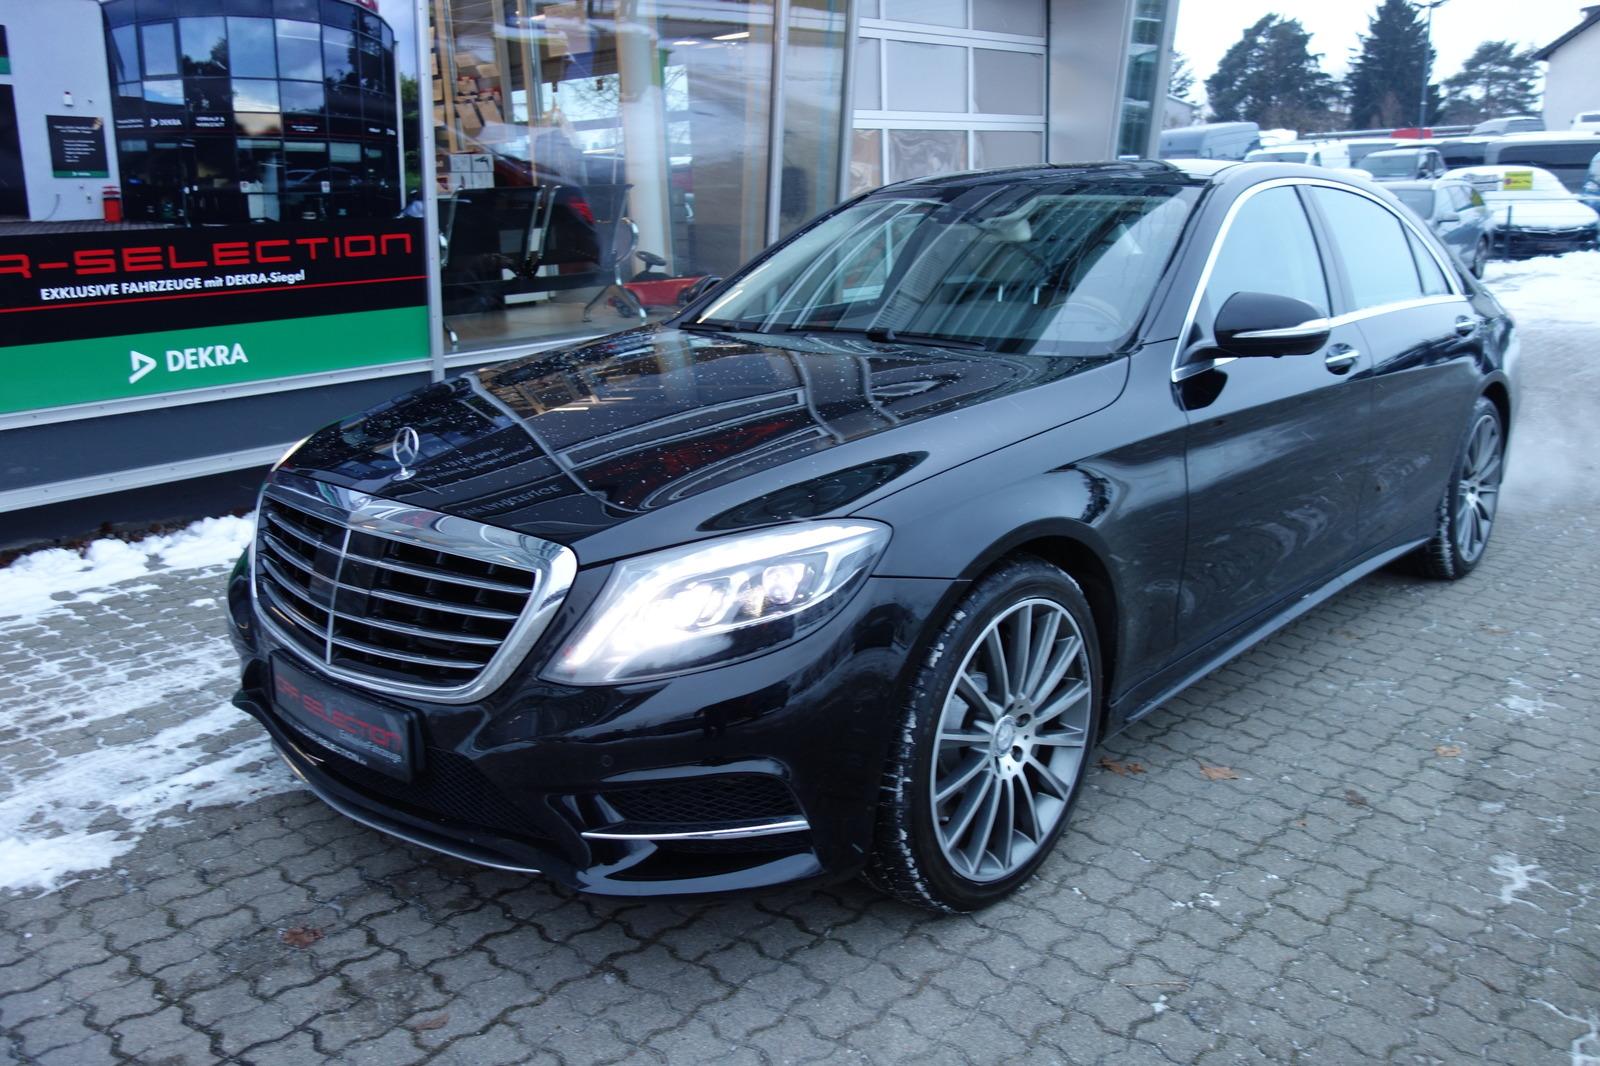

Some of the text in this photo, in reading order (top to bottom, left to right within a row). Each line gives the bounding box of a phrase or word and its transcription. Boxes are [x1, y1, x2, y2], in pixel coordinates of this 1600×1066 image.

[40, 268, 305, 301] EXKLUSIVE FAHRZEUGE mit DEKRA-Siegel
[165, 342, 249, 372] DEKRA
